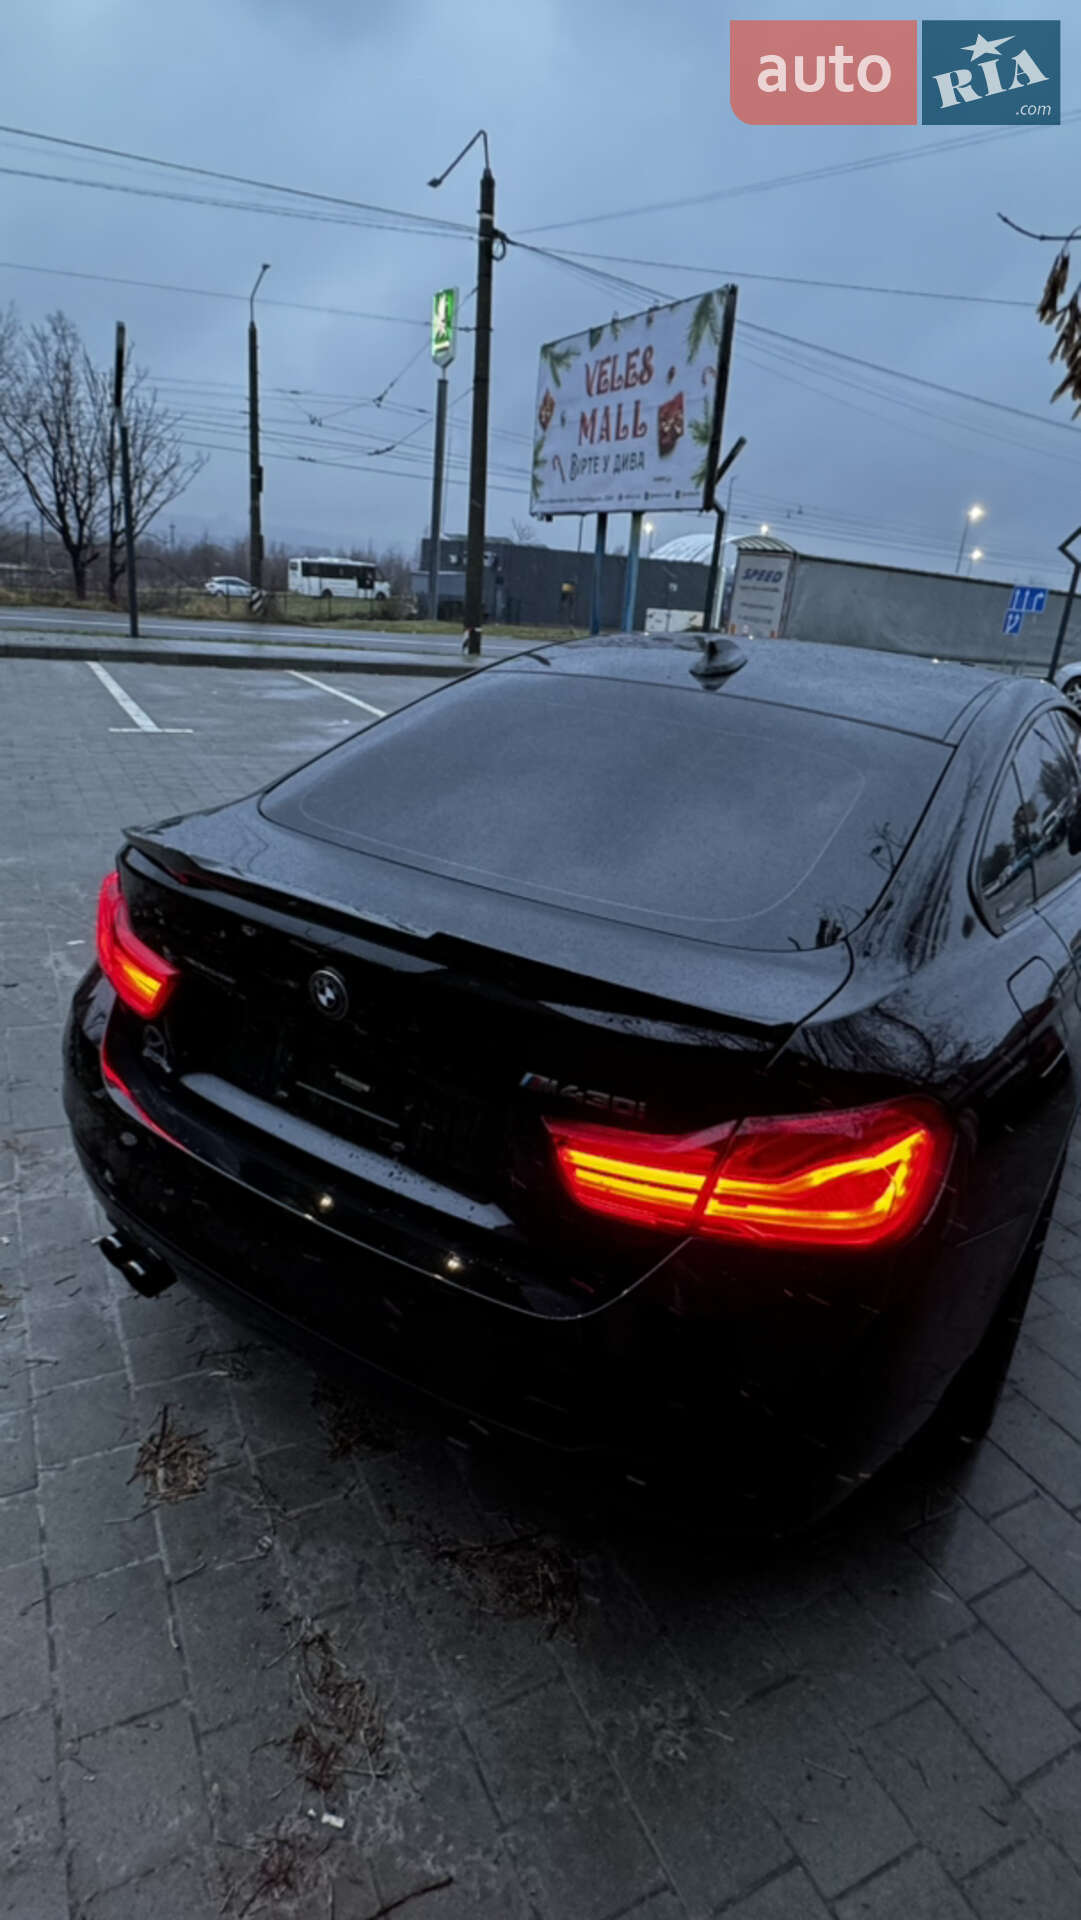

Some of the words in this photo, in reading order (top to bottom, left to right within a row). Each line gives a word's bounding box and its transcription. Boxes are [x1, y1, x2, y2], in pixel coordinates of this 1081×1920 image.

[585, 345, 654, 398] VELES
[578, 401, 648, 446] MALL
[612, 451, 645, 475] ДИВА
[742, 568, 783, 583] SPEED
